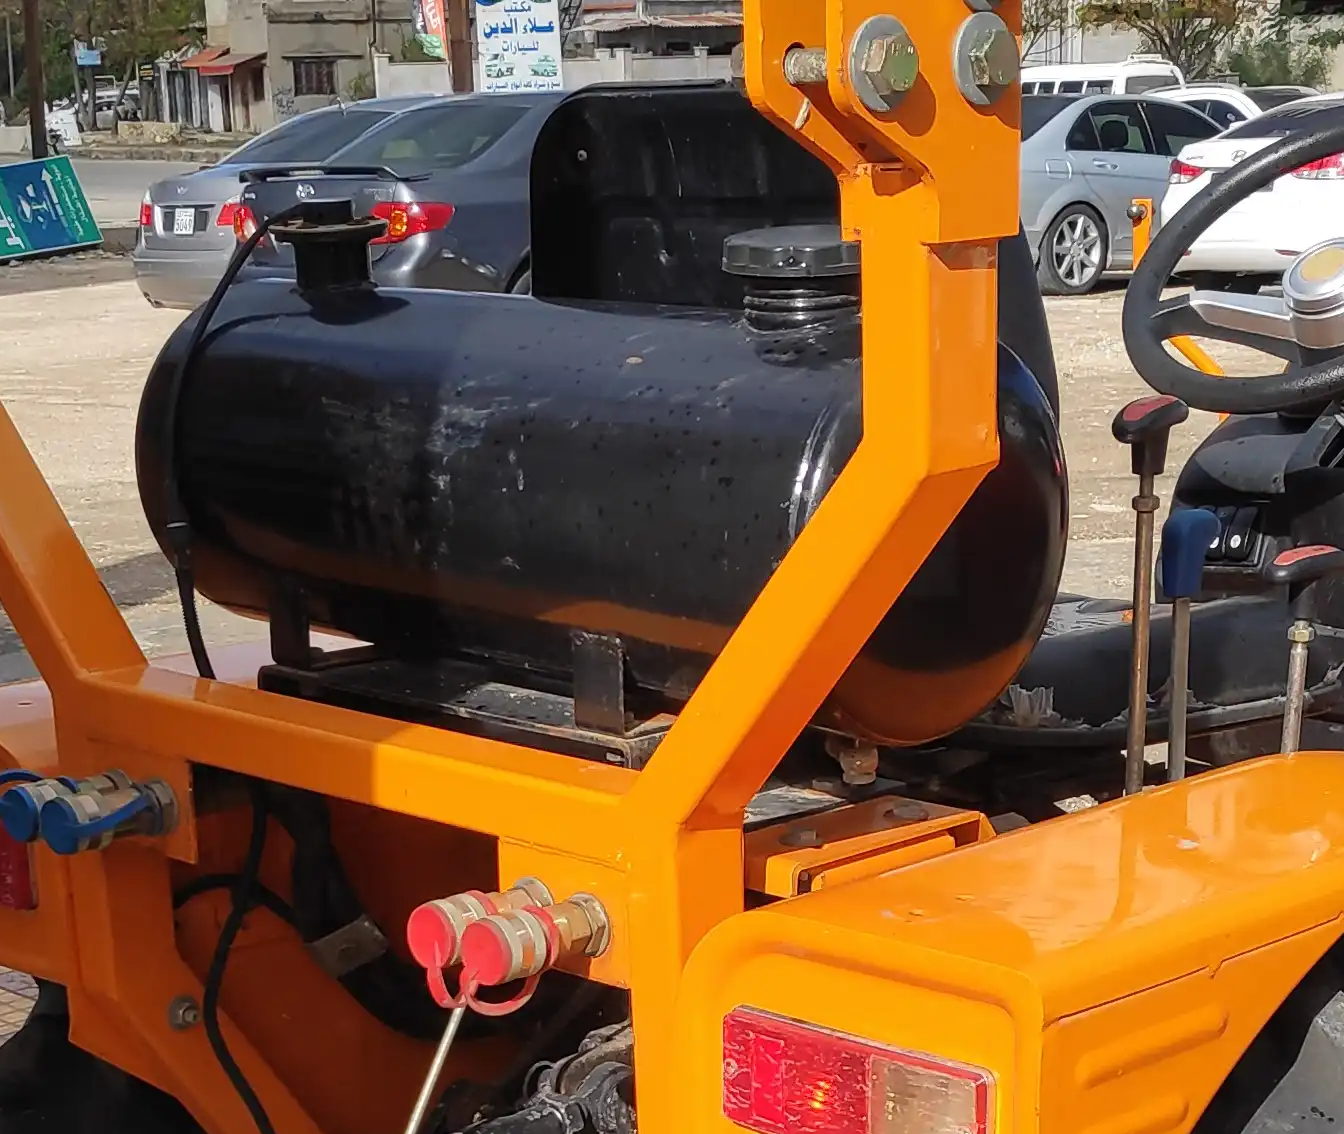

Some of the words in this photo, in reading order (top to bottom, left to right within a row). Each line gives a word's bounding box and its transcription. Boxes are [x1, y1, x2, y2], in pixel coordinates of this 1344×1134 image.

[503, 1, 531, 17] مكتب
[483, 17, 518, 39] الدين
[522, 17, 555, 35] علاء
[502, 40, 539, 55] للسيارات
